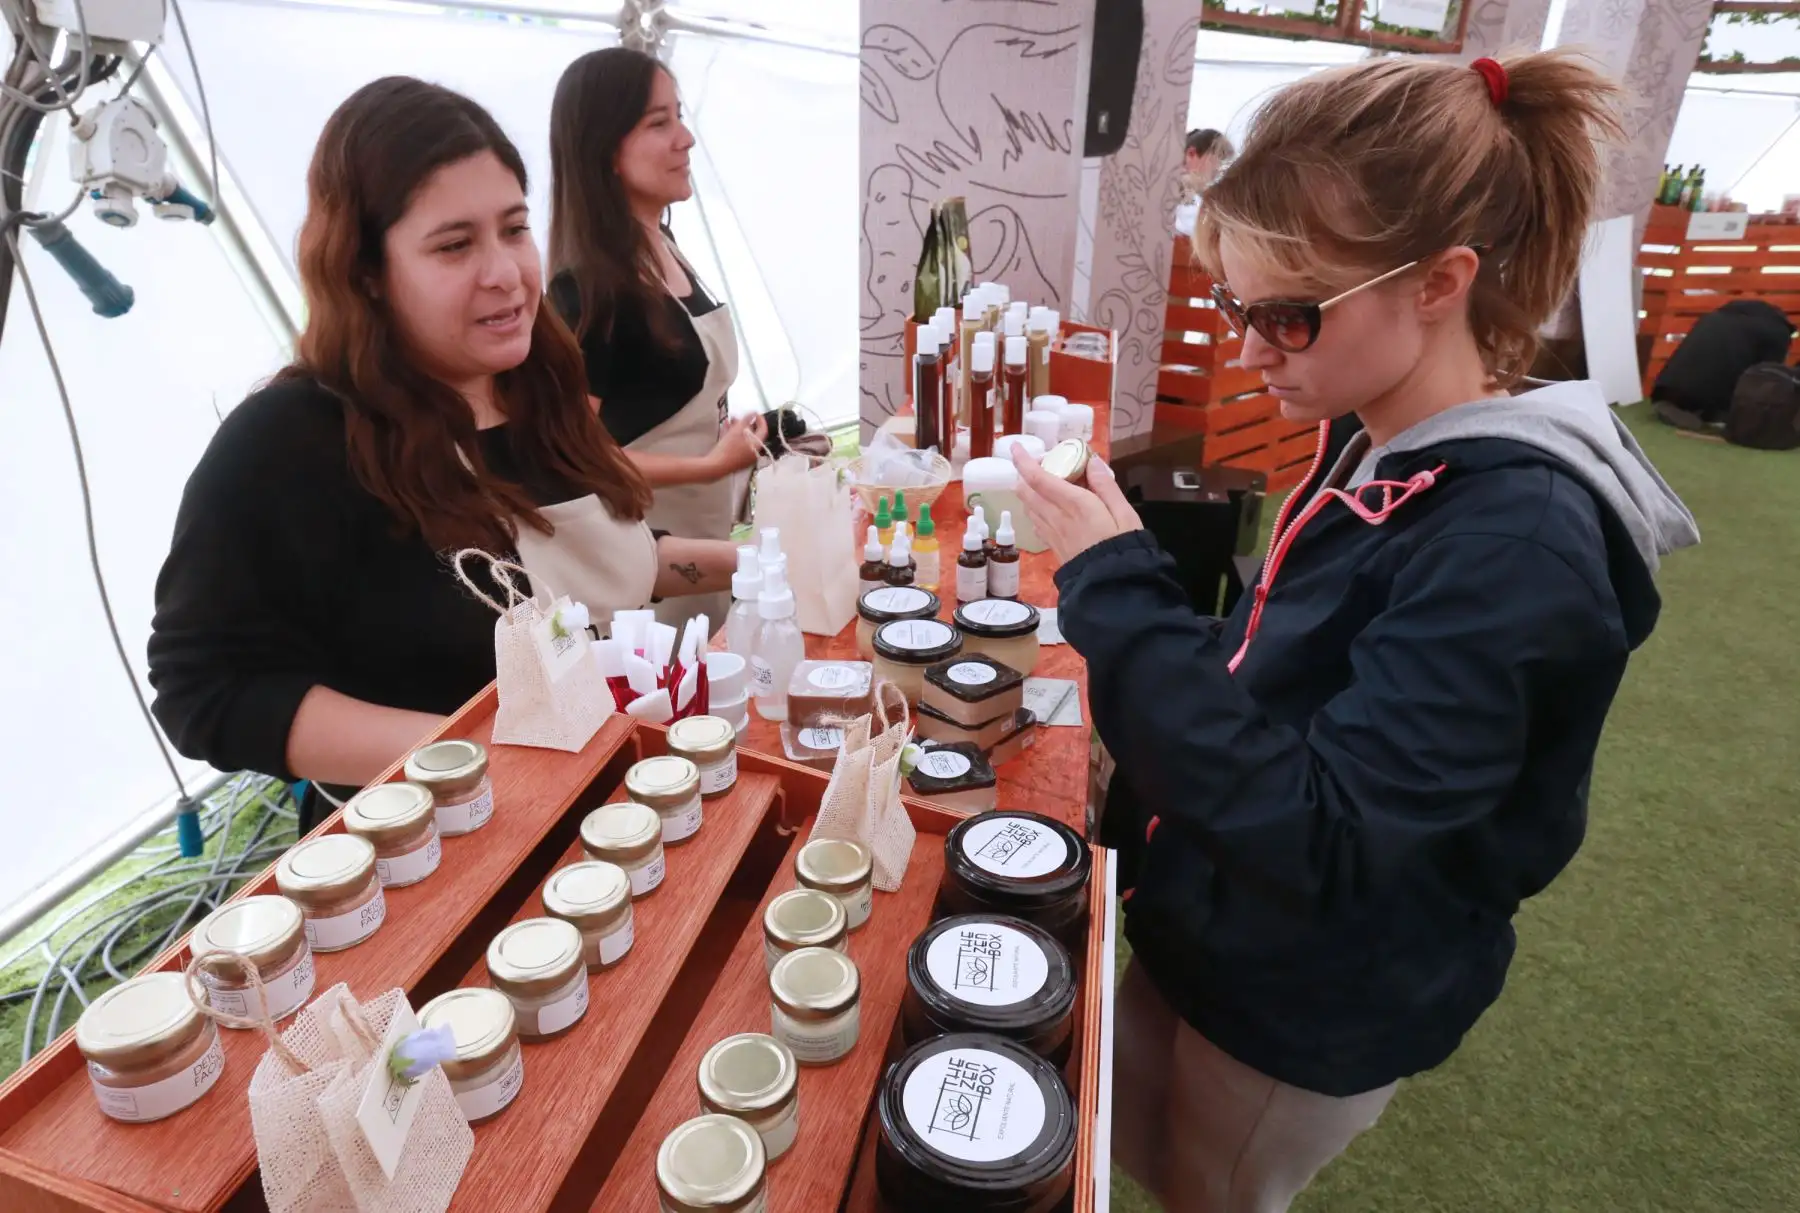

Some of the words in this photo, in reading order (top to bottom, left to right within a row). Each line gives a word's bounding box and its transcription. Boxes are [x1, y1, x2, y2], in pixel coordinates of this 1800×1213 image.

[1000, 821, 1021, 836] THE
[1009, 825, 1031, 842] ZEN
[1019, 829, 1041, 846] BOX
[960, 931, 974, 953] THE
[973, 933, 988, 954] ZEN
[987, 934, 1002, 957] BOX
[944, 1057, 965, 1086] THE
[959, 1061, 981, 1090] ZEN
[976, 1064, 998, 1096] BOX
